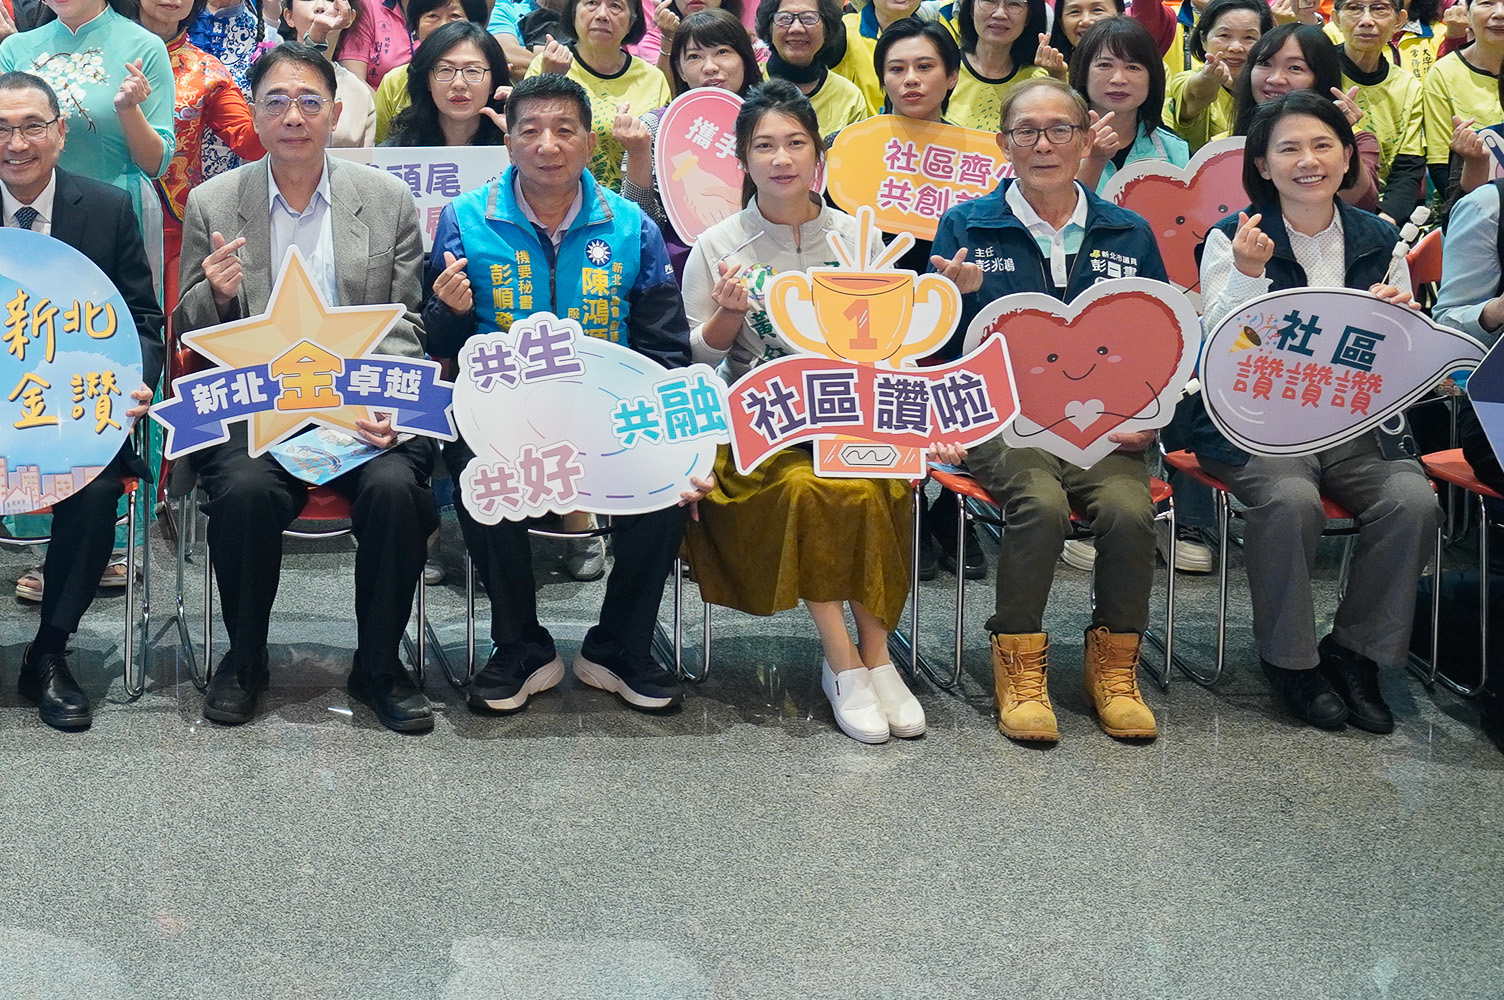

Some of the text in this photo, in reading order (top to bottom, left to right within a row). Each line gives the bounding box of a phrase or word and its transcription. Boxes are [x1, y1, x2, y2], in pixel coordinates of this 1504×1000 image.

[366, 163, 461, 198] 頭尾
[515, 250, 533, 310] 機要秘書
[974, 246, 994, 258] 主任
[1101, 250, 1138, 266] 新北市議員
[489, 263, 515, 332] 彭順發
[841, 299, 878, 350] 1
[470, 322, 584, 389] 共生
[1276, 310, 1385, 373] 社區
[613, 375, 729, 448] 共融
[1234, 354, 1383, 415] 讚讚讚
[471, 439, 584, 512] 共好
